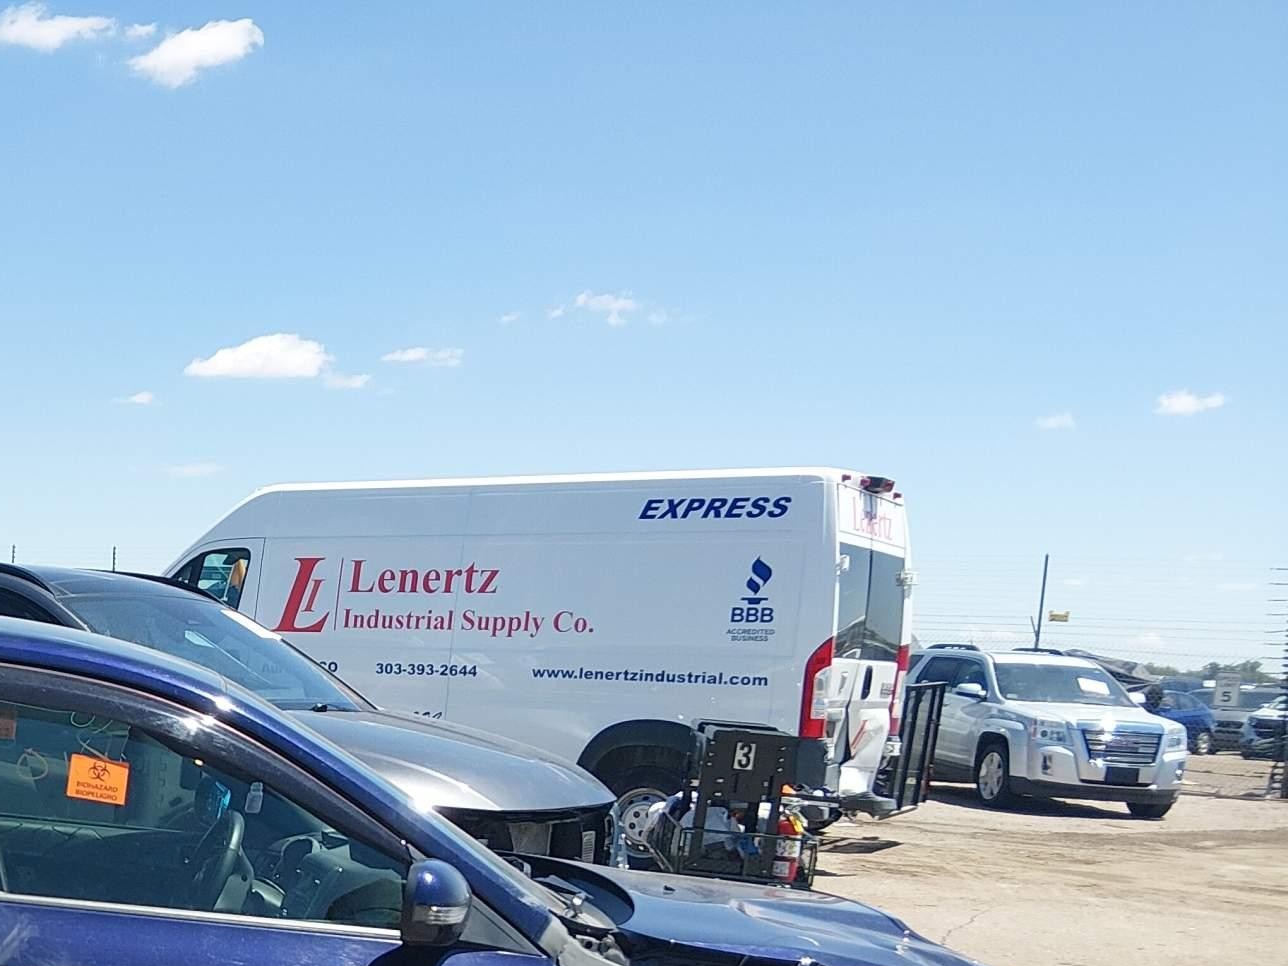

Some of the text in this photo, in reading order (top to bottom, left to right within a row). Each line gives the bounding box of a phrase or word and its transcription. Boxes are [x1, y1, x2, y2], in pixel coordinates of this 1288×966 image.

[638, 496, 792, 520] EXPRESS
[348, 560, 500, 594] Lenertz
[343, 608, 595, 638] Industrial Supply Co.
[730, 607, 774, 623] BBB
[375, 662, 477, 677] 303-393-2644
[532, 667, 769, 686] www.lenertzindustrial.com
[1220, 691, 1232, 702] 5
[738, 743, 752, 769] 3
[76, 781, 118, 794] BIOHAZARD
